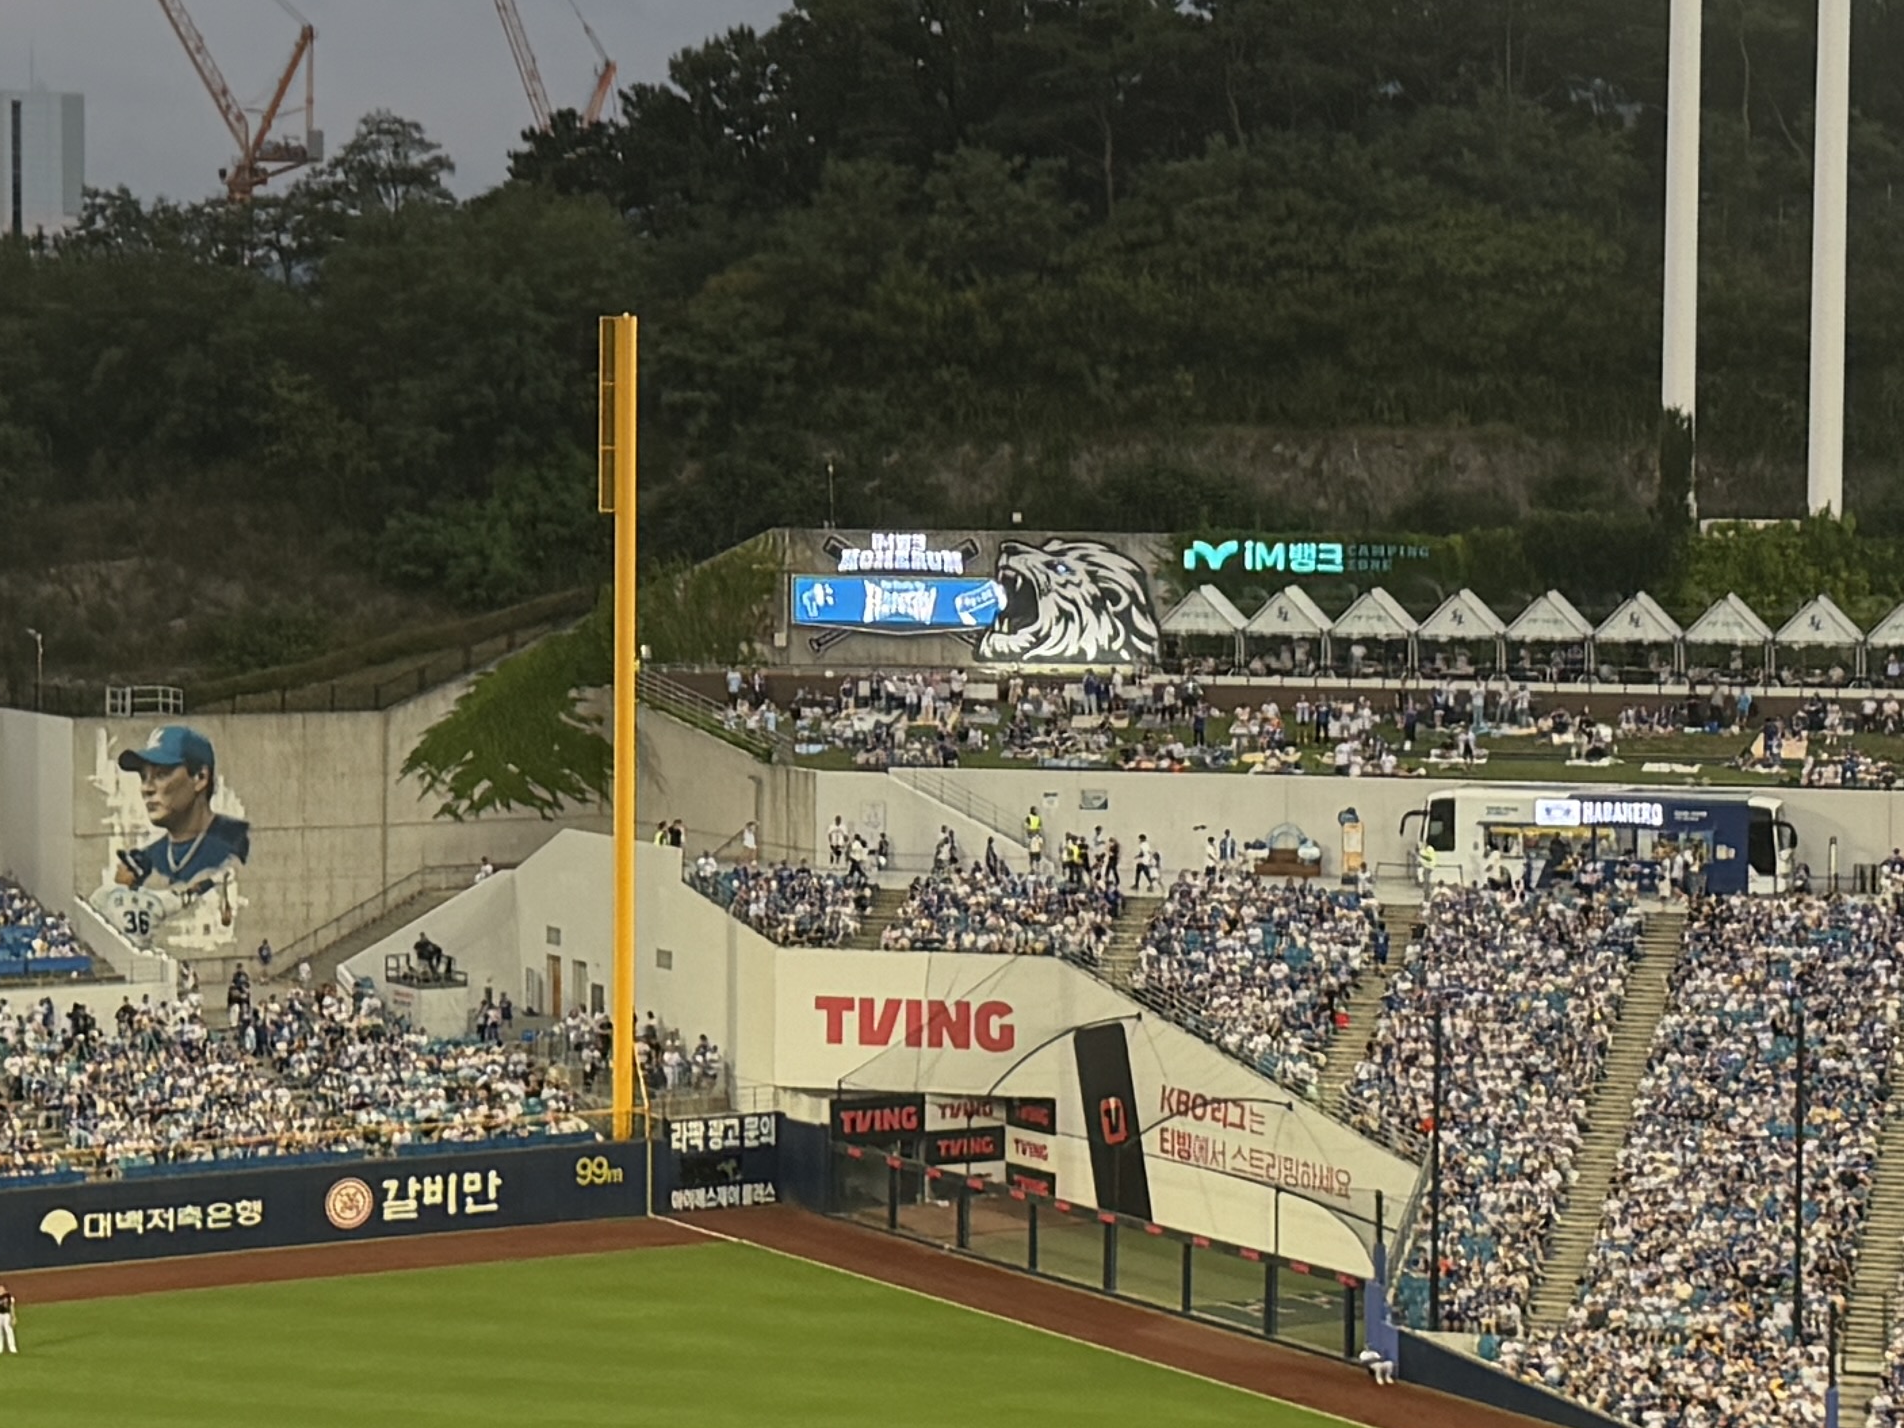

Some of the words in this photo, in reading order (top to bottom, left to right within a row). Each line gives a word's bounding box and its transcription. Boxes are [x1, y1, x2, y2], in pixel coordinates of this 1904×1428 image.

[1582, 801, 1663, 827] HABANERO
[123, 911, 150, 934] 36
[815, 996, 1015, 1052] TVING
[840, 1106, 919, 1134] TVING
[1160, 1084, 1265, 1136] KBO리그는
[671, 1120, 705, 1153] 라팍
[708, 1118, 740, 1150] 광고
[744, 1115, 776, 1147] 문의
[937, 1136, 995, 1157] TVING
[1014, 1138, 1048, 1160] TVING
[575, 1157, 623, 1186] 99m
[1160, 1127, 1226, 1169] 티빙에서
[1231, 1144, 1351, 1199] 스트리밍하세요
[382, 1169, 503, 1220] 갈비만
[83, 1198, 262, 1238] 대백저축은행
